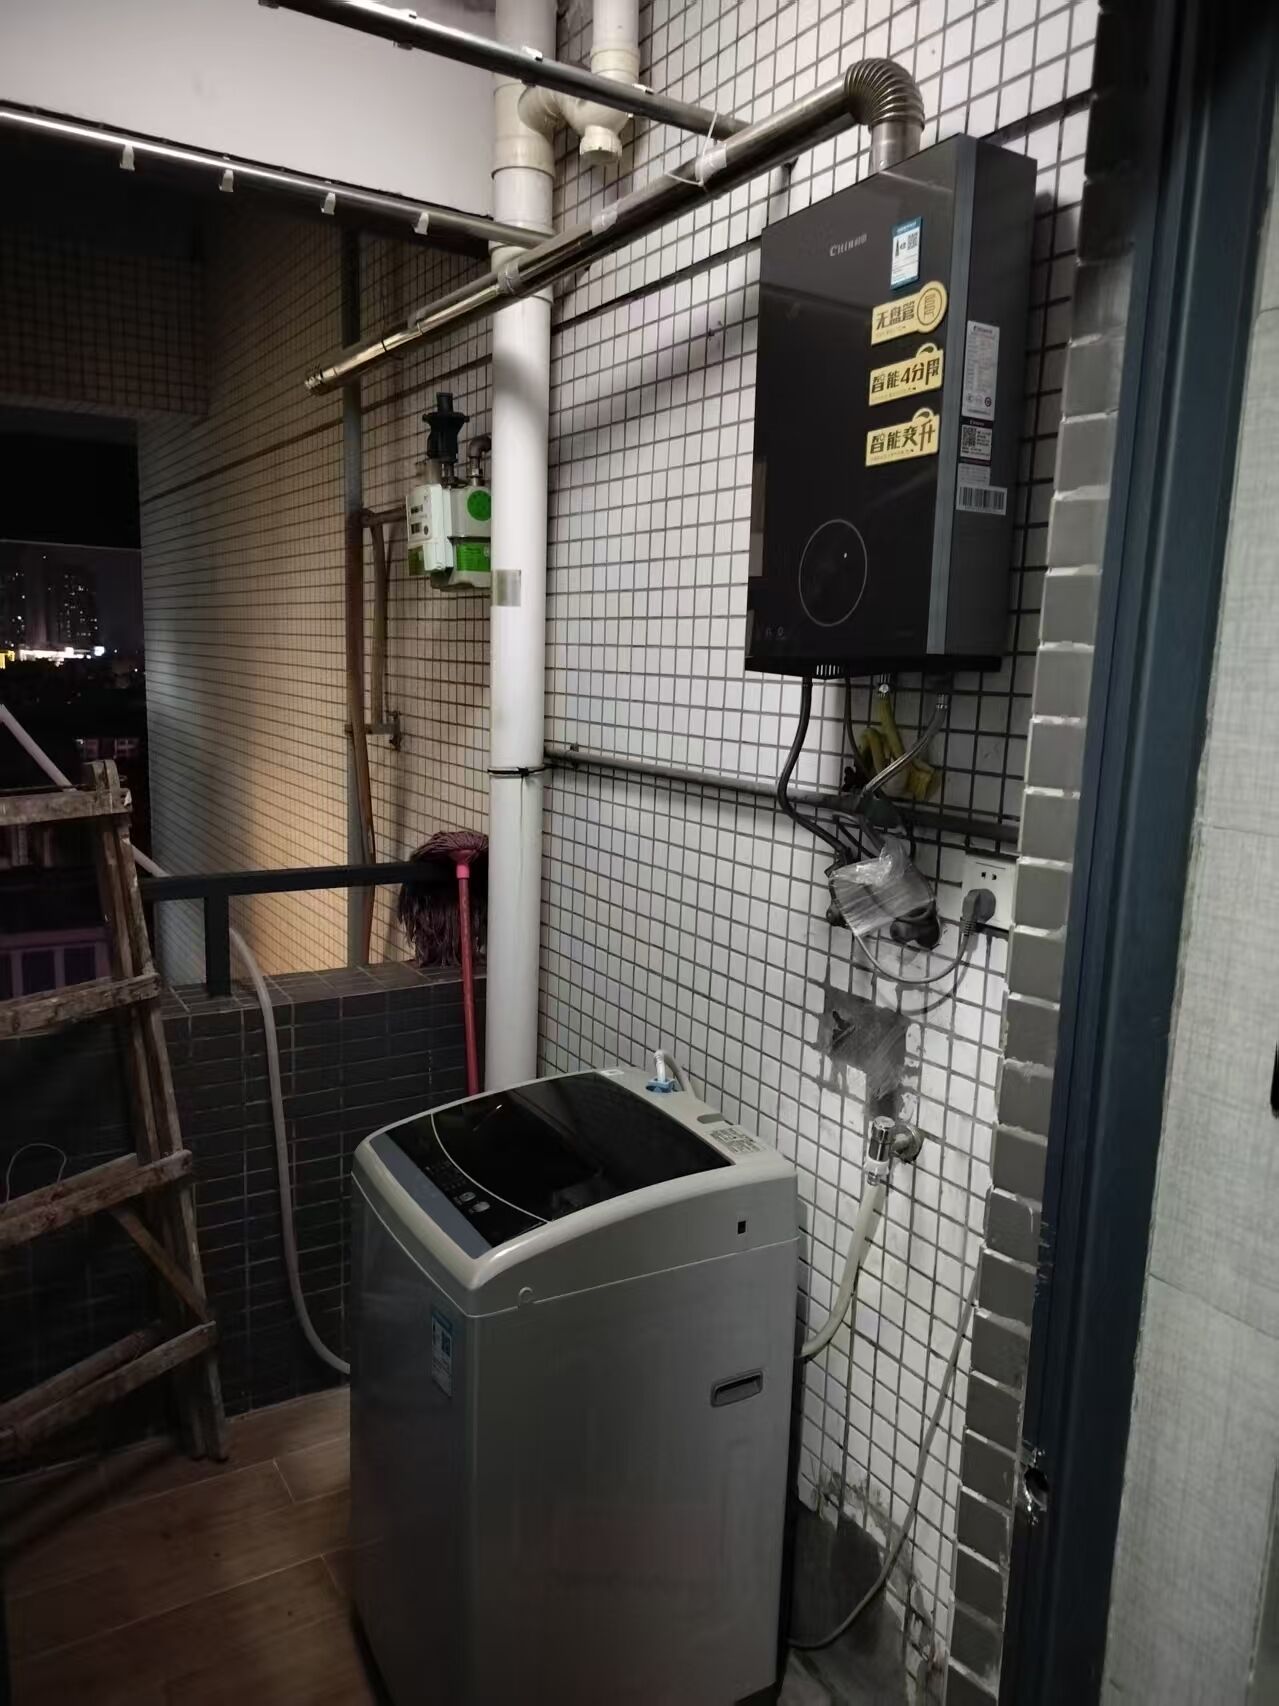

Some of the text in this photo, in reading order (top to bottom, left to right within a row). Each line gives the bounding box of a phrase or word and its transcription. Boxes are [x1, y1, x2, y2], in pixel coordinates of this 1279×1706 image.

[876, 301, 916, 331] 无盘管
[869, 420, 936, 455] 智能变升
